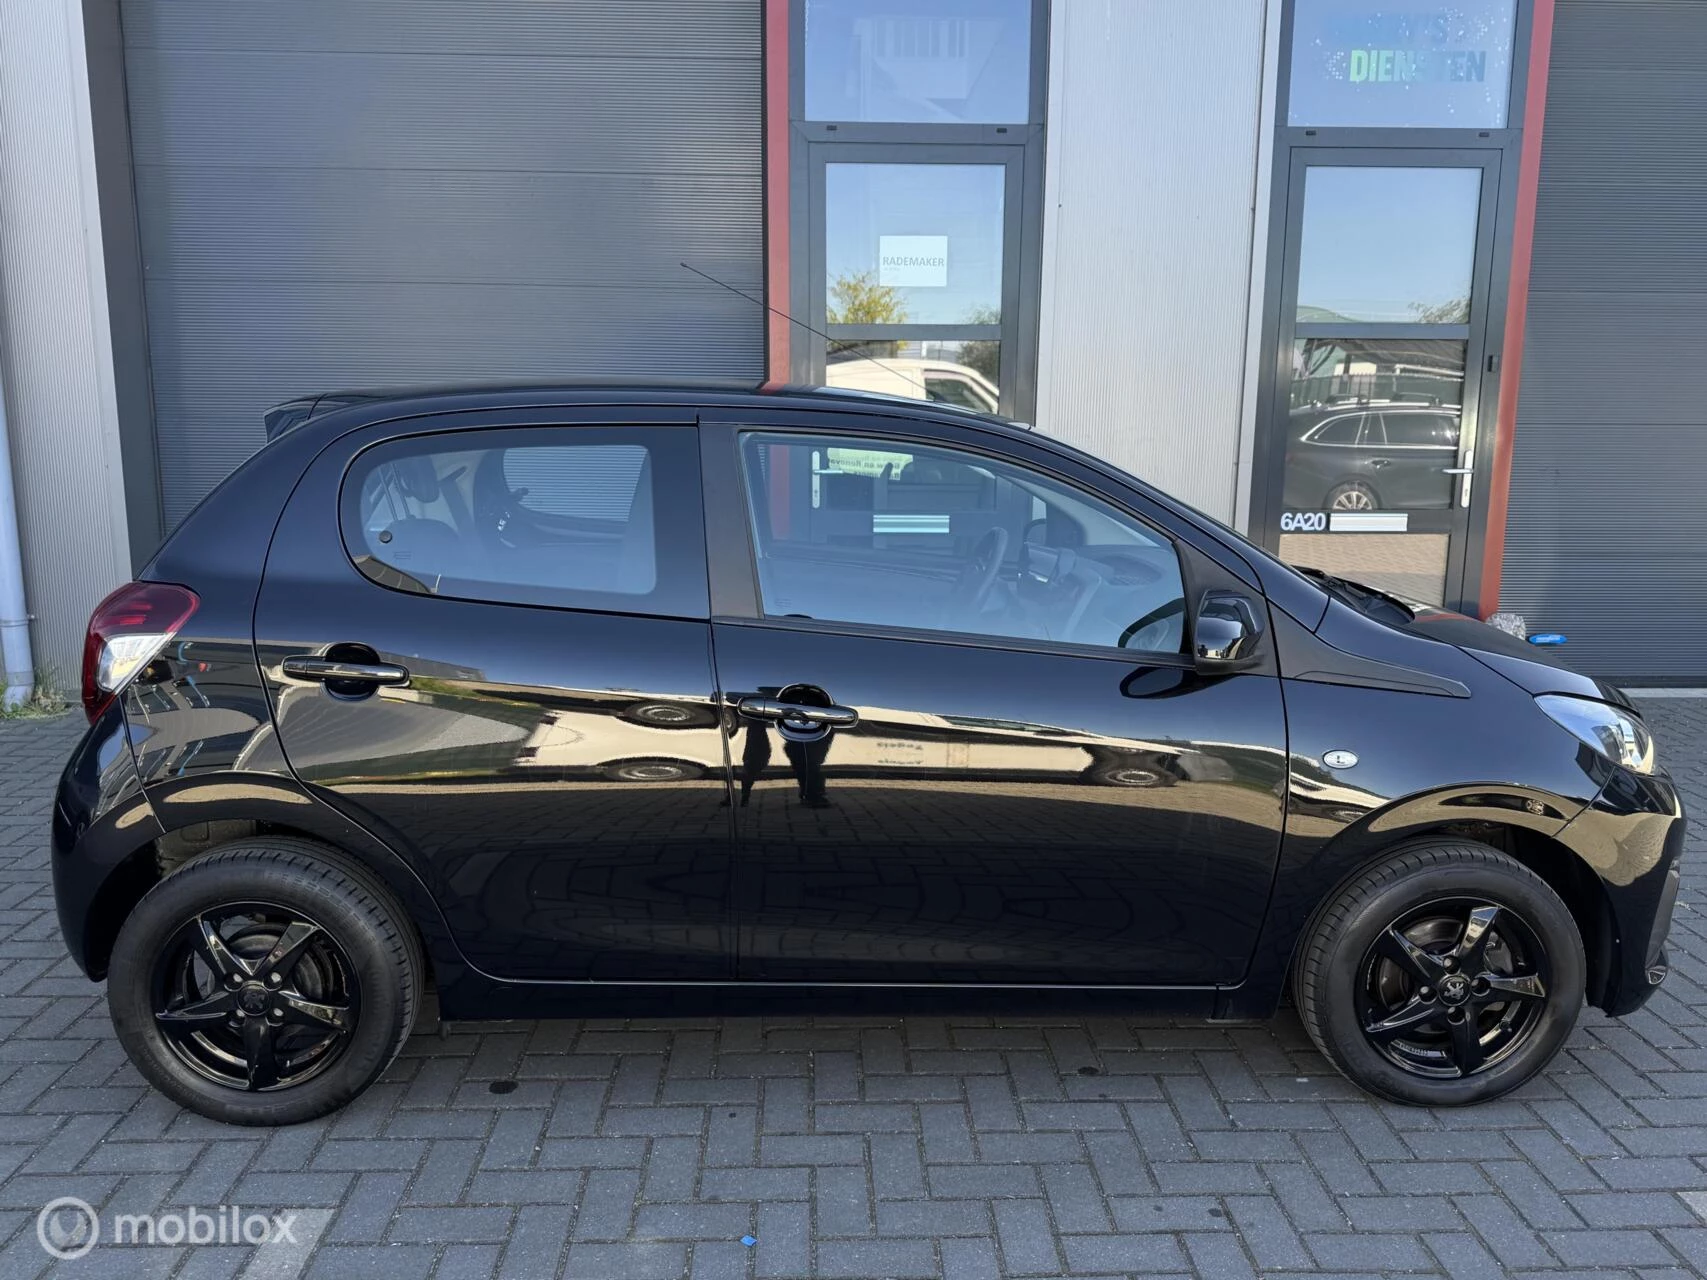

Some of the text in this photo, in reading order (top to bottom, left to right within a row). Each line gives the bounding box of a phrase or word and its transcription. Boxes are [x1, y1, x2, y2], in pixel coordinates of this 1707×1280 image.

[1350, 49, 1487, 82] DIENSEN
[882, 256, 945, 267] RADEMAKER
[1280, 512, 1327, 531] 6A20
